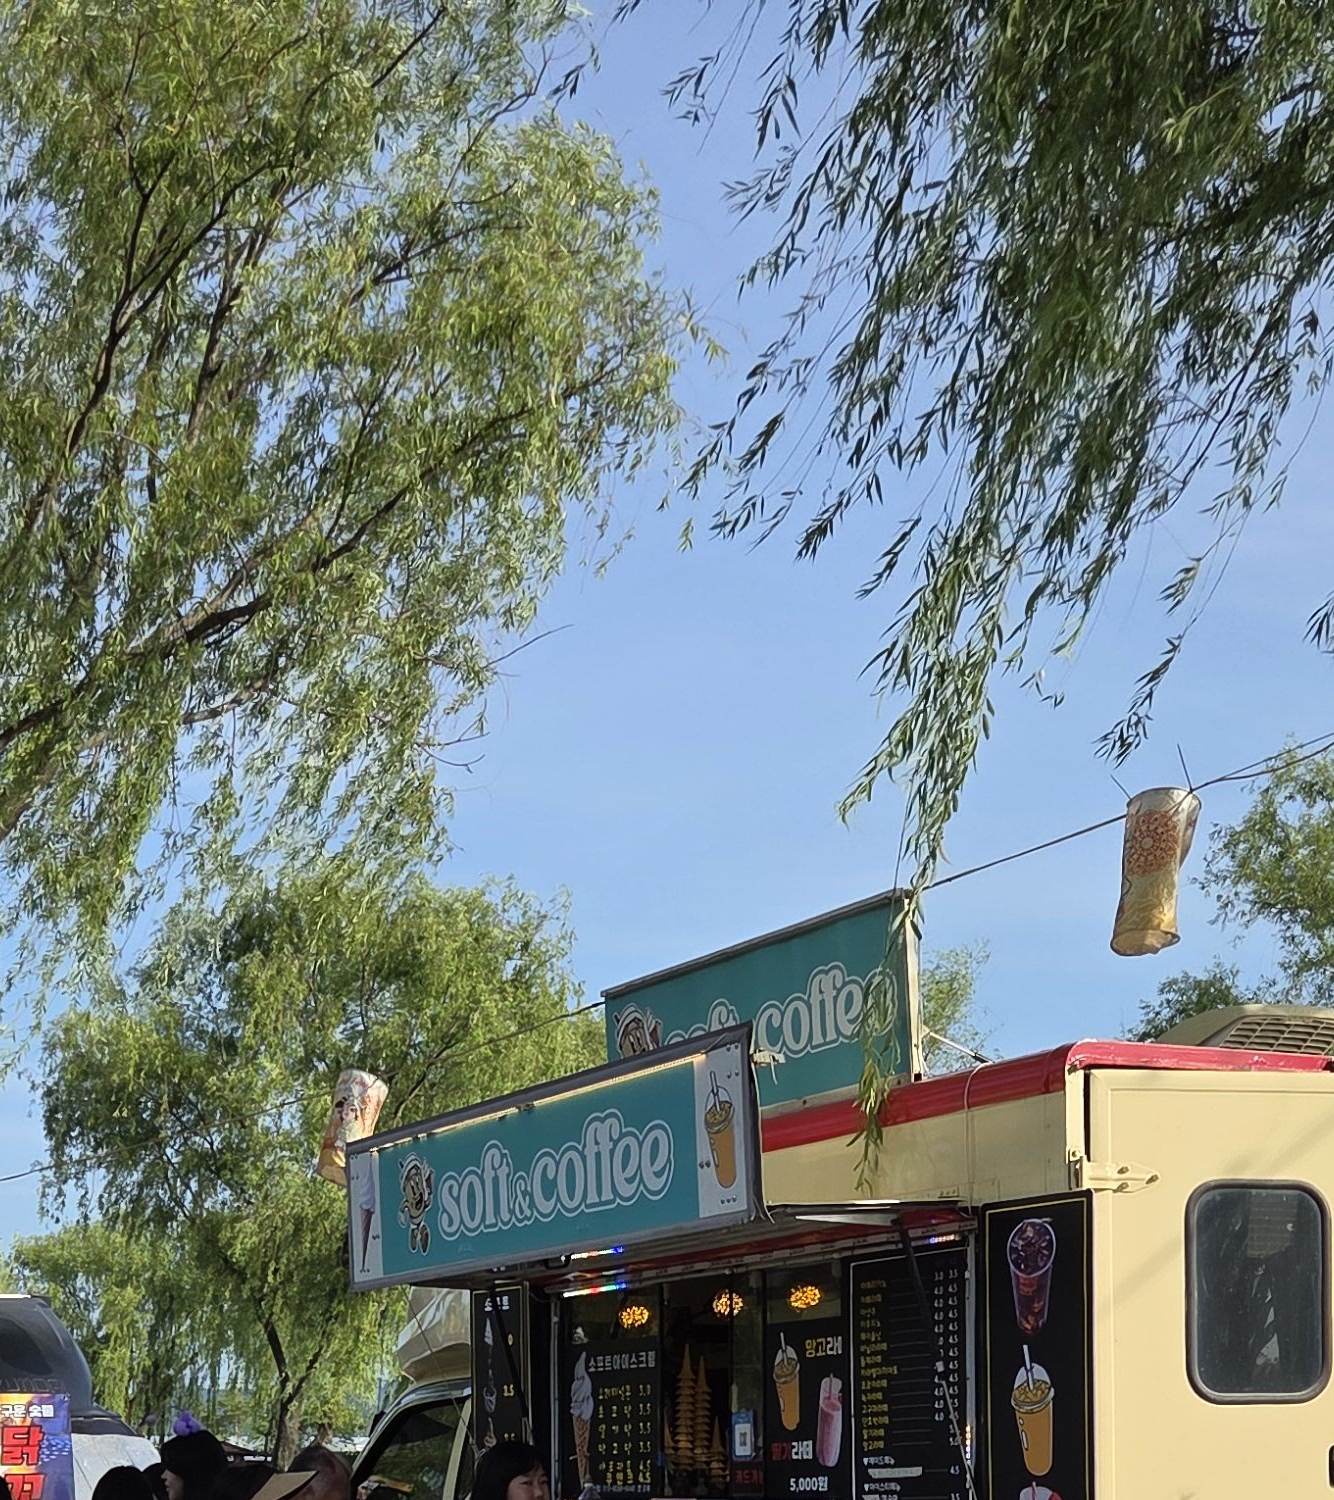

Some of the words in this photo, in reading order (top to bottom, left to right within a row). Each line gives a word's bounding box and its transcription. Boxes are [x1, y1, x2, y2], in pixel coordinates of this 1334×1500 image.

[440, 1110, 673, 1240] soft&coffee
[587, 1350, 657, 1373] 소프트아이스크림
[1, 1404, 27, 1418] 구운
[789, 1475, 829, 1493] 5,000원
